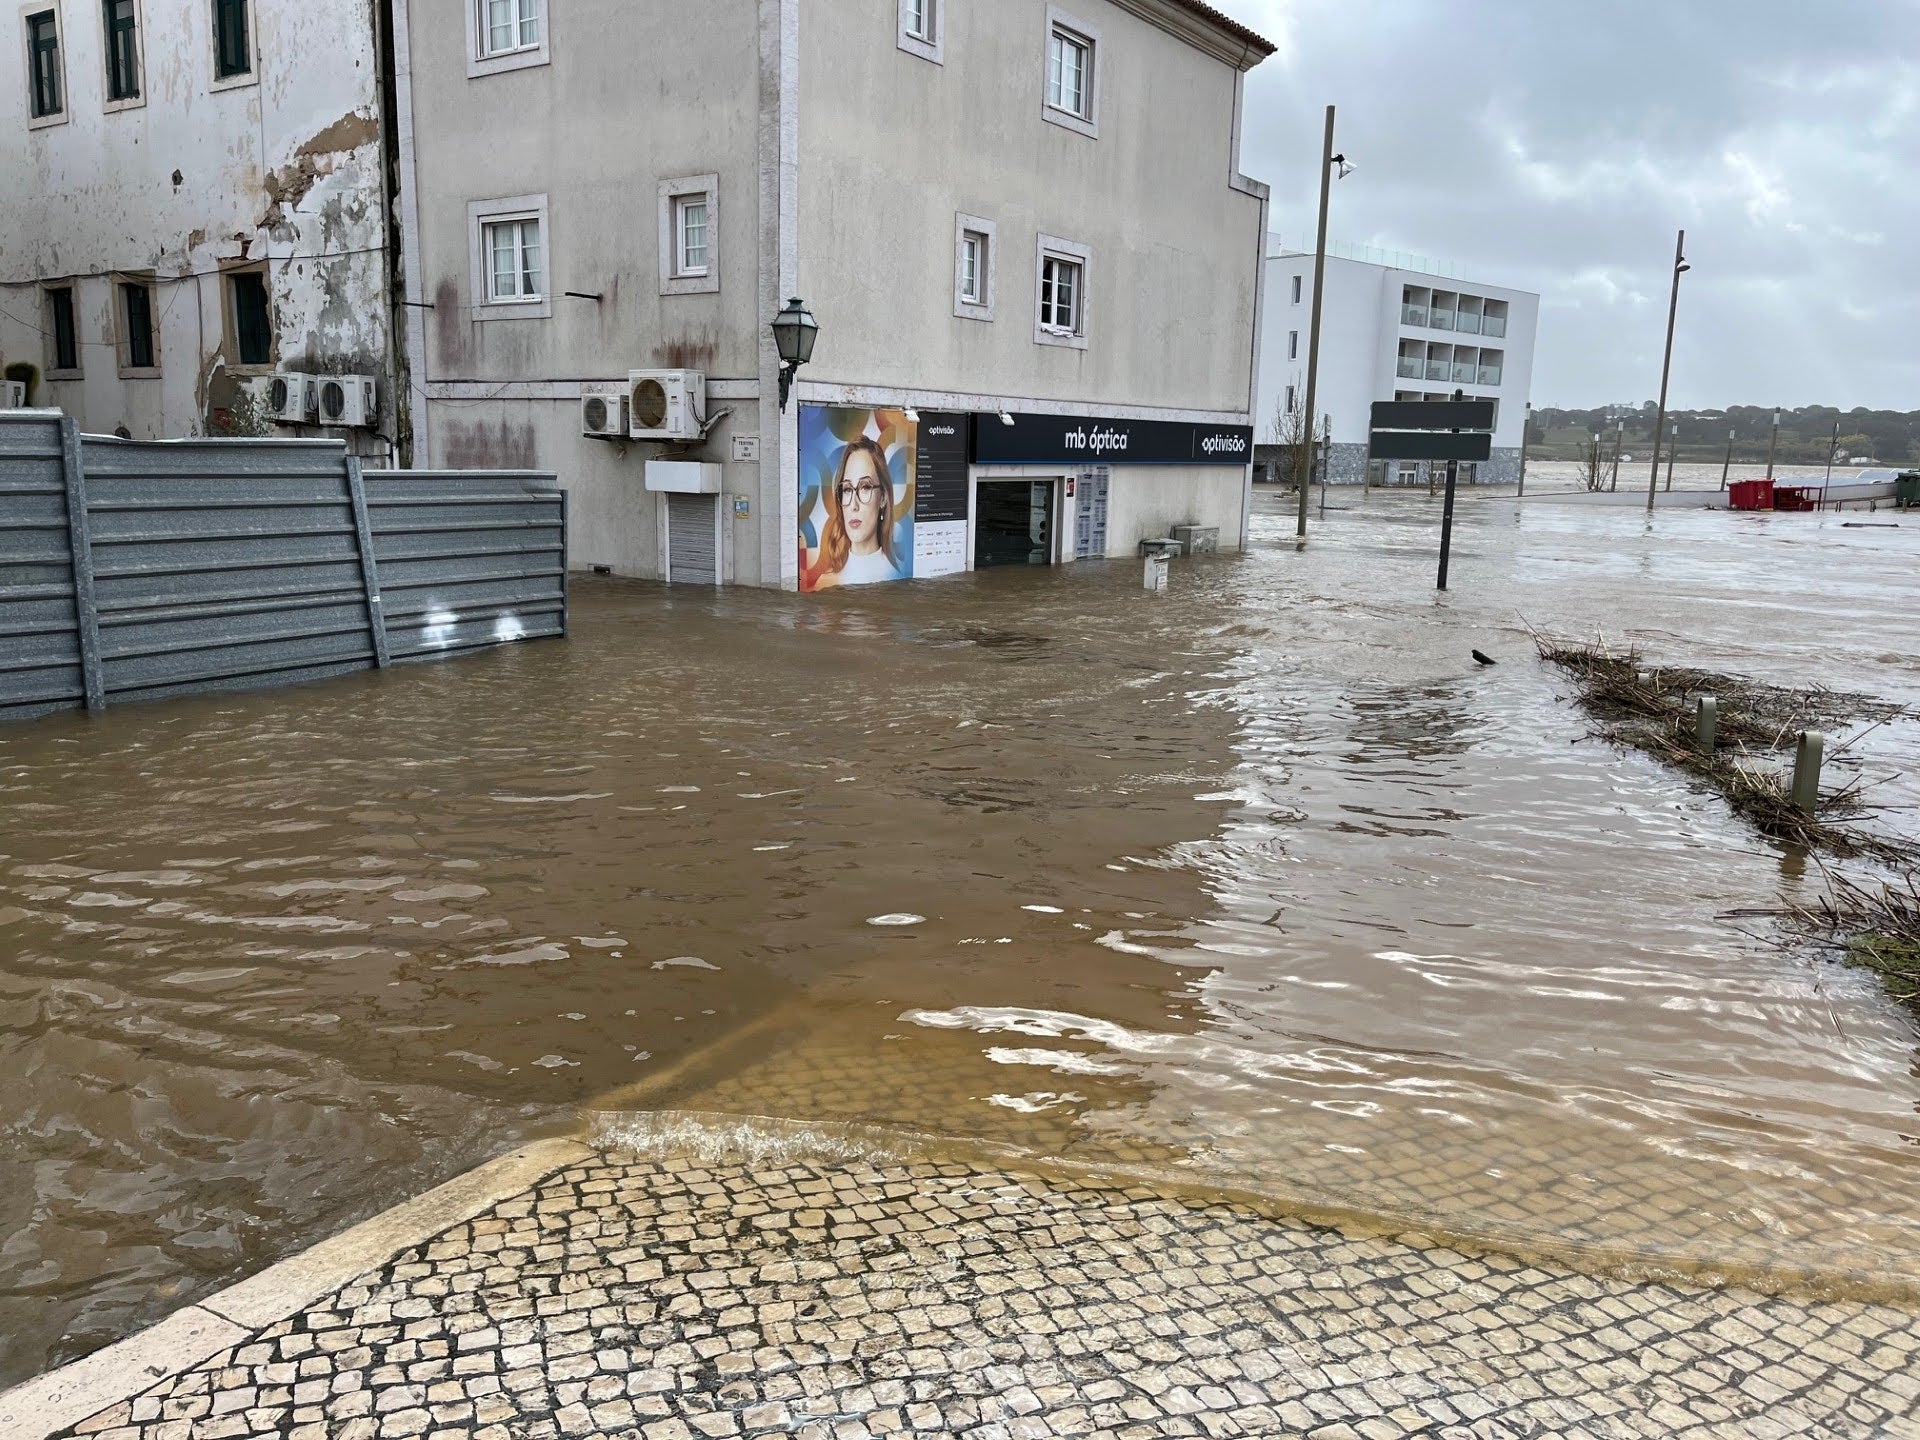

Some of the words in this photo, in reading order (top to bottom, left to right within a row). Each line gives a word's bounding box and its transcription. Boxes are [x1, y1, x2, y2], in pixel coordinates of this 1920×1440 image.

[1065, 426, 1086, 449] mb
[1089, 425, 1128, 455] óptica
[1201, 434, 1246, 455] optivisão
